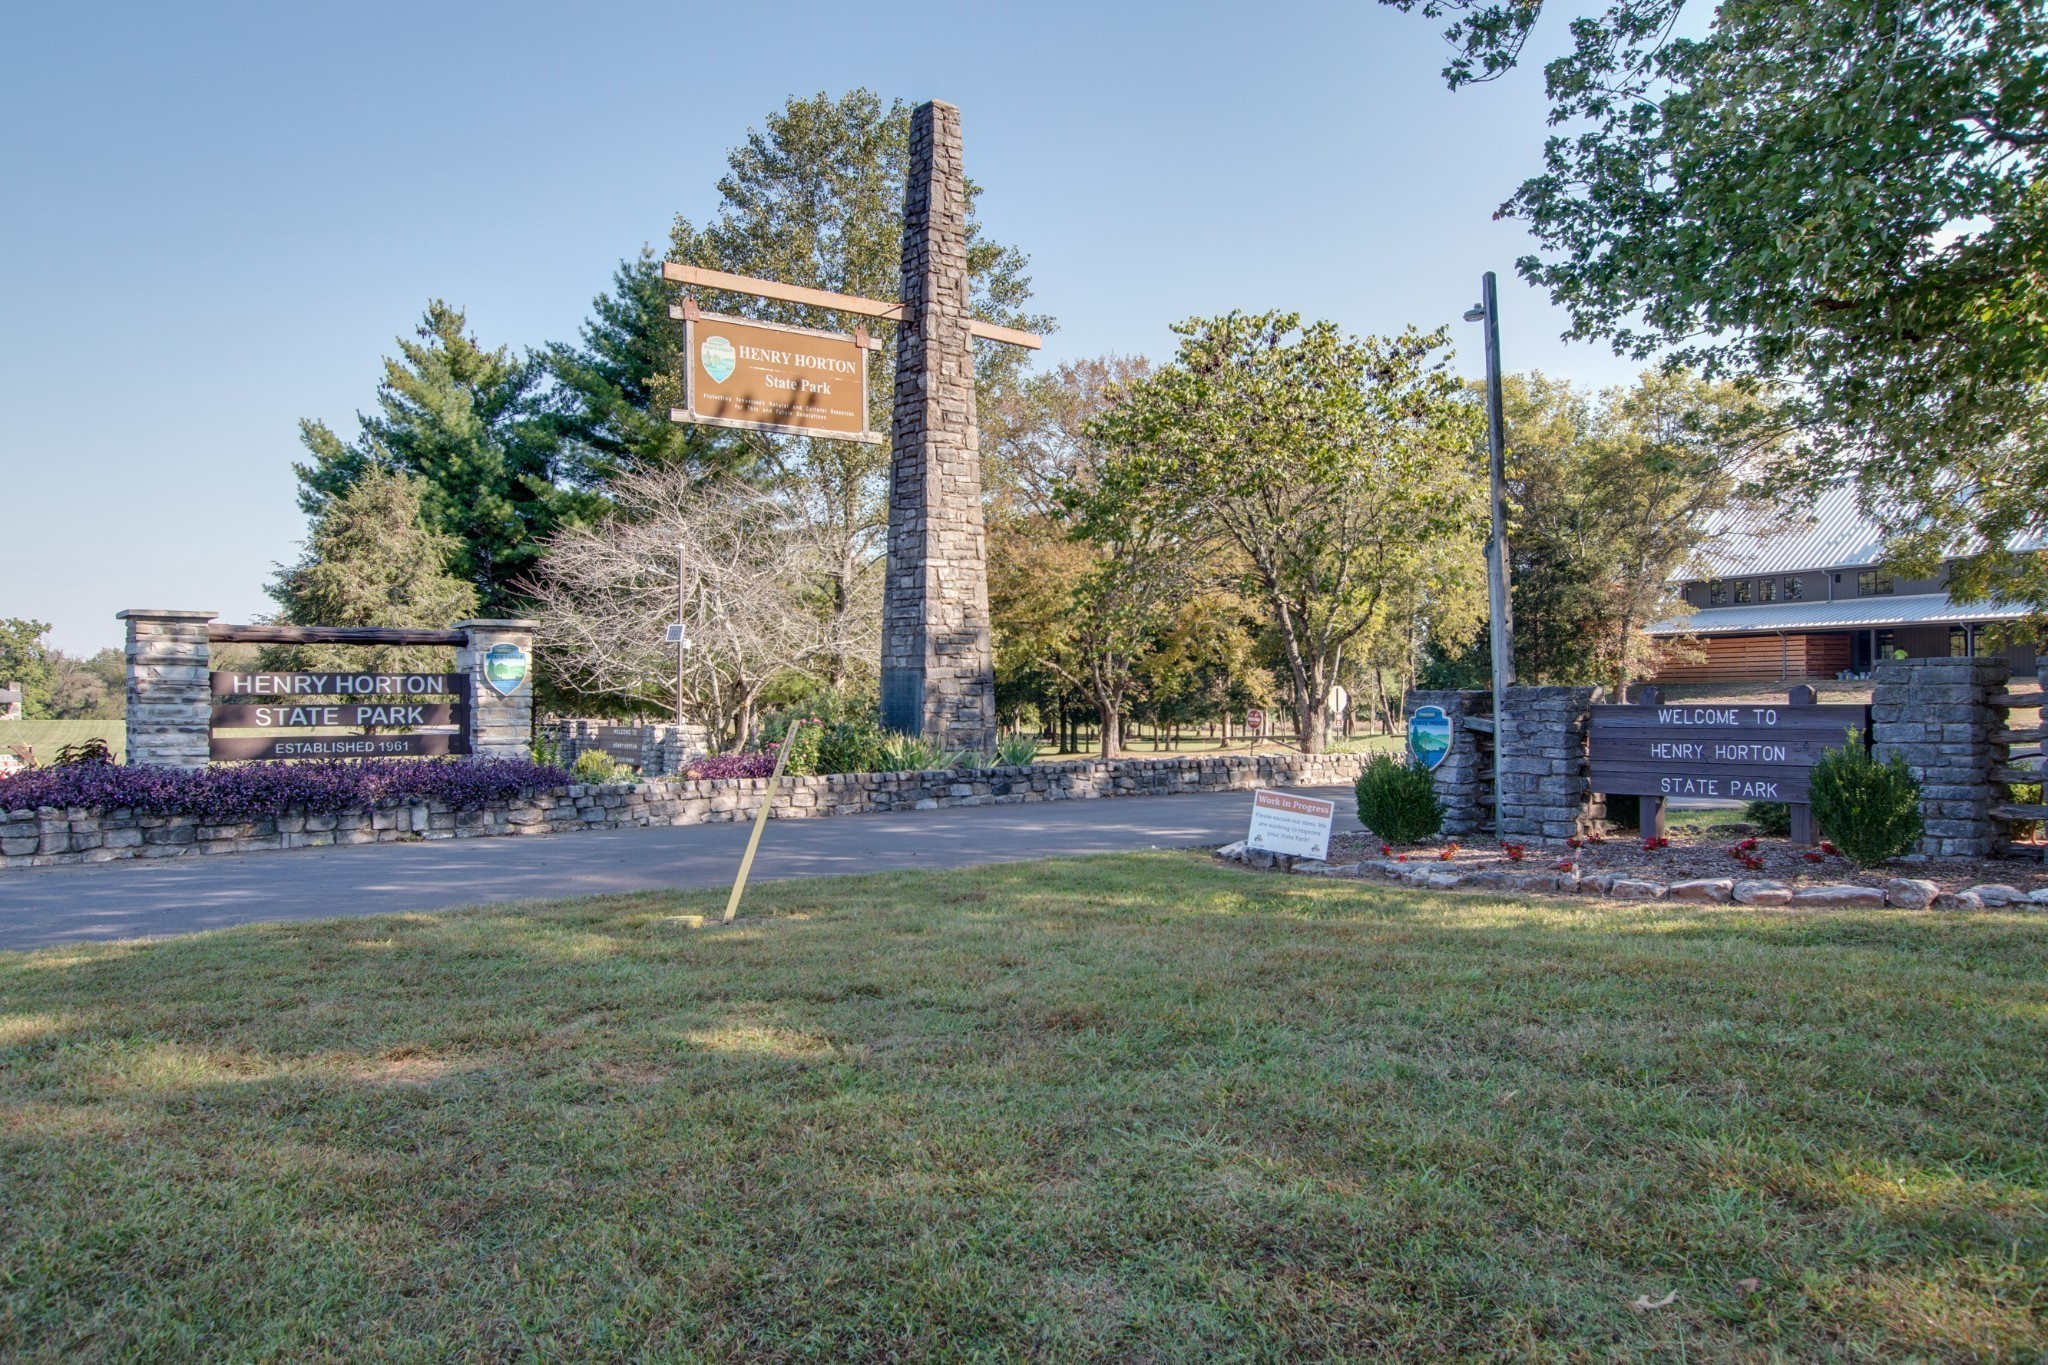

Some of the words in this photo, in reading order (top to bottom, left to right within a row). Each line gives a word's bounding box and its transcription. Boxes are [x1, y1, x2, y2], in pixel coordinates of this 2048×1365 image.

[739, 345, 791, 365] HENRY
[794, 353, 856, 374] HORTON
[765, 374, 797, 391] State
[801, 379, 831, 395] Park
[703, 392, 732, 402] Protecting
[768, 401, 789, 409] Natural
[805, 405, 827, 413] Cultural
[830, 408, 855, 417] Resources
[796, 411, 827, 420] Generations
[233, 675, 328, 694] HENRY
[336, 675, 443, 694] HORTON
[255, 706, 339, 726] STATE
[357, 706, 424, 725] PARK
[1658, 709, 1739, 725] WELCOME
[1752, 709, 1777, 725] TO
[275, 741, 375, 754] ESTABLISHED
[379, 741, 409, 752] 1961
[1651, 743, 1703, 760] HENRY
[1715, 745, 1785, 762] HORTON
[1661, 778, 1718, 795] STATE
[1731, 781, 1778, 798] PARK
[1258, 794, 1281, 806] Work
[1282, 798, 1291, 807] in
[1293, 801, 1329, 814] Progress
